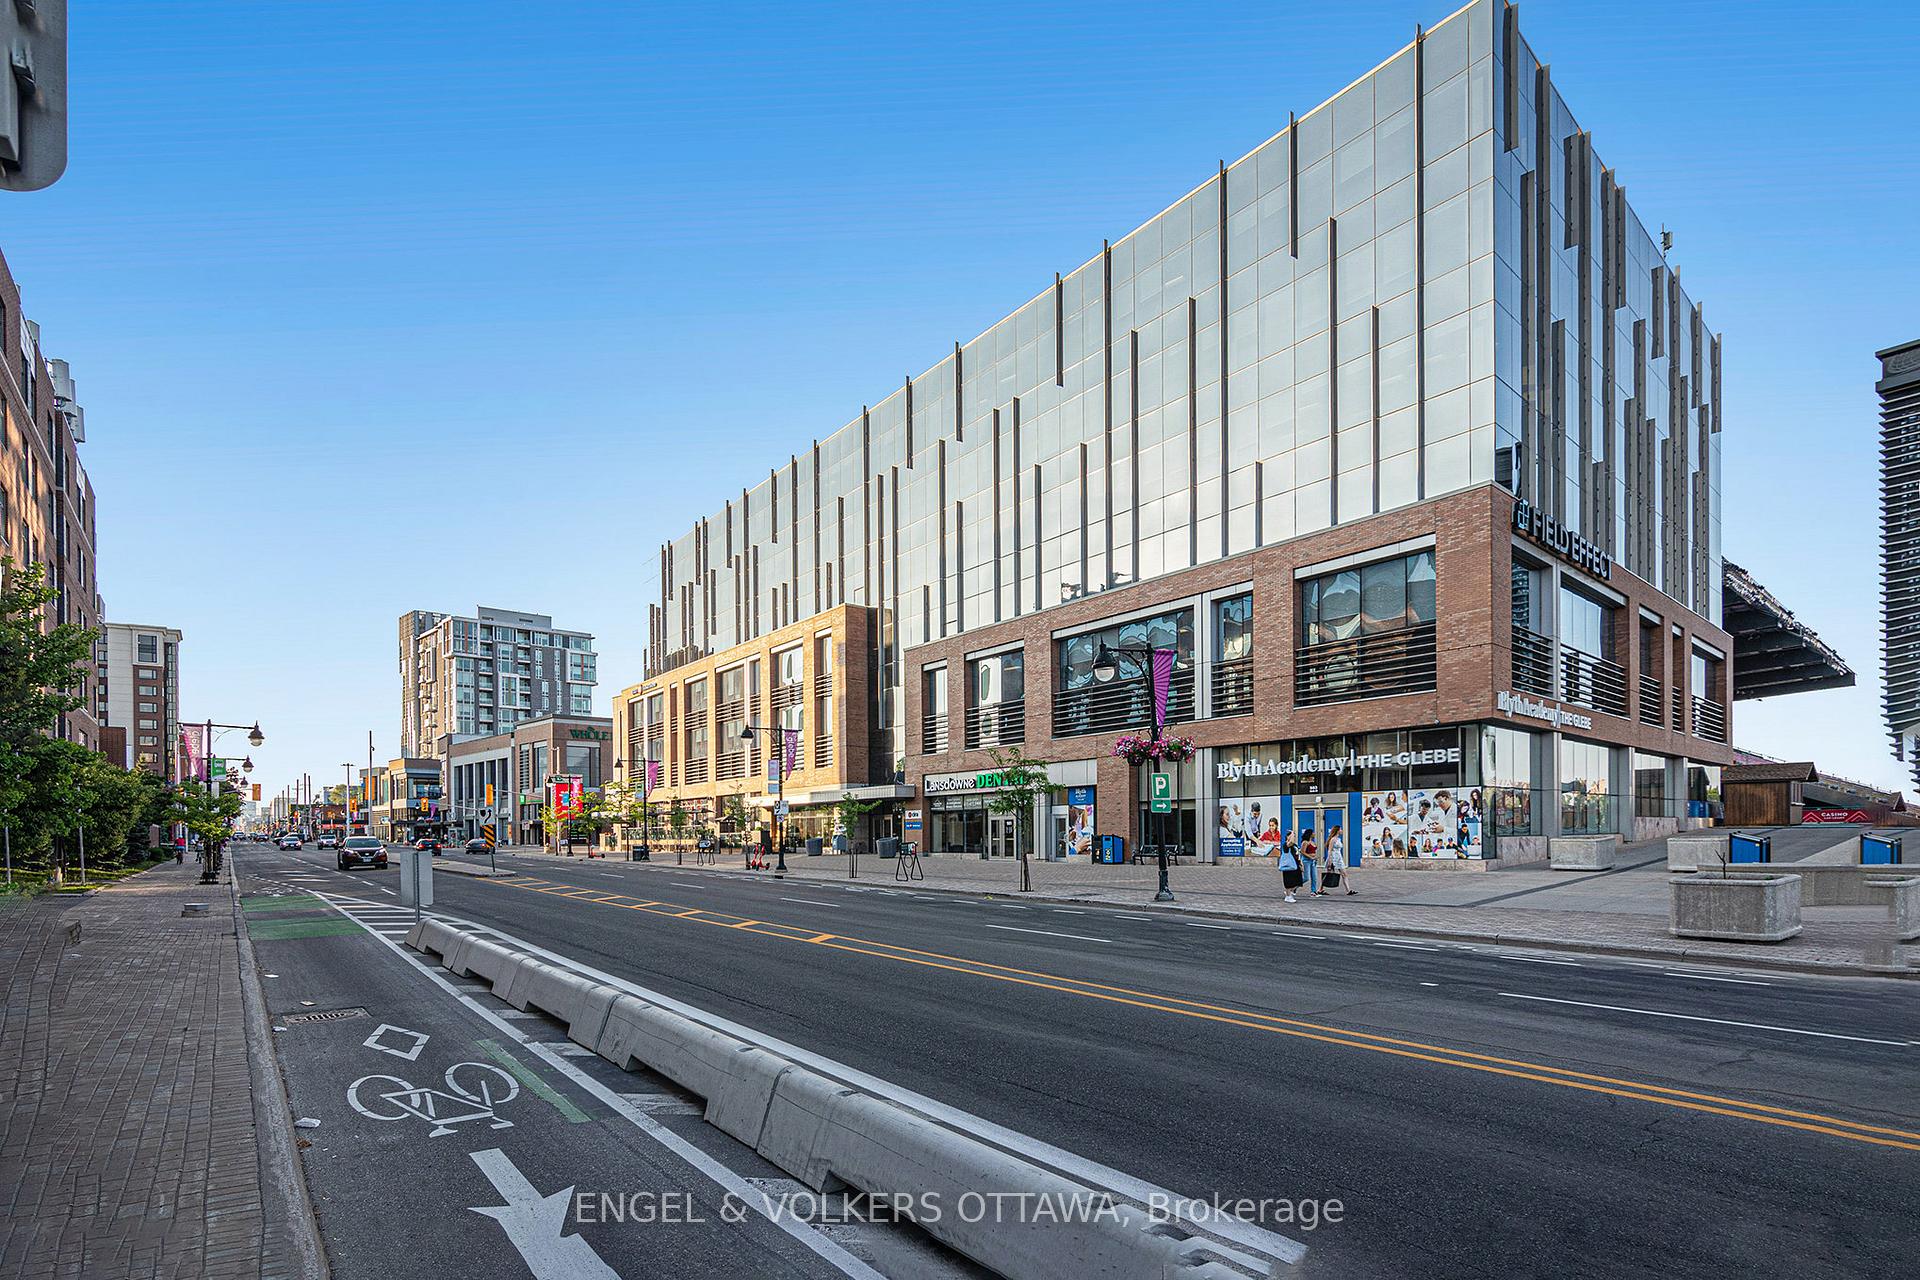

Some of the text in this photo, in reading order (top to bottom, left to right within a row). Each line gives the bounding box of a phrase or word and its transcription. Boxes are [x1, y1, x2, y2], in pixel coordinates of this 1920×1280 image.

[1533, 507, 1615, 580] FIELD EFFECT
[569, 726, 609, 740] WHOLE
[1217, 754, 1349, 782] Blyth Academy
[1358, 747, 1460, 769] THE GLEBE
[1155, 776, 1167, 796] P
